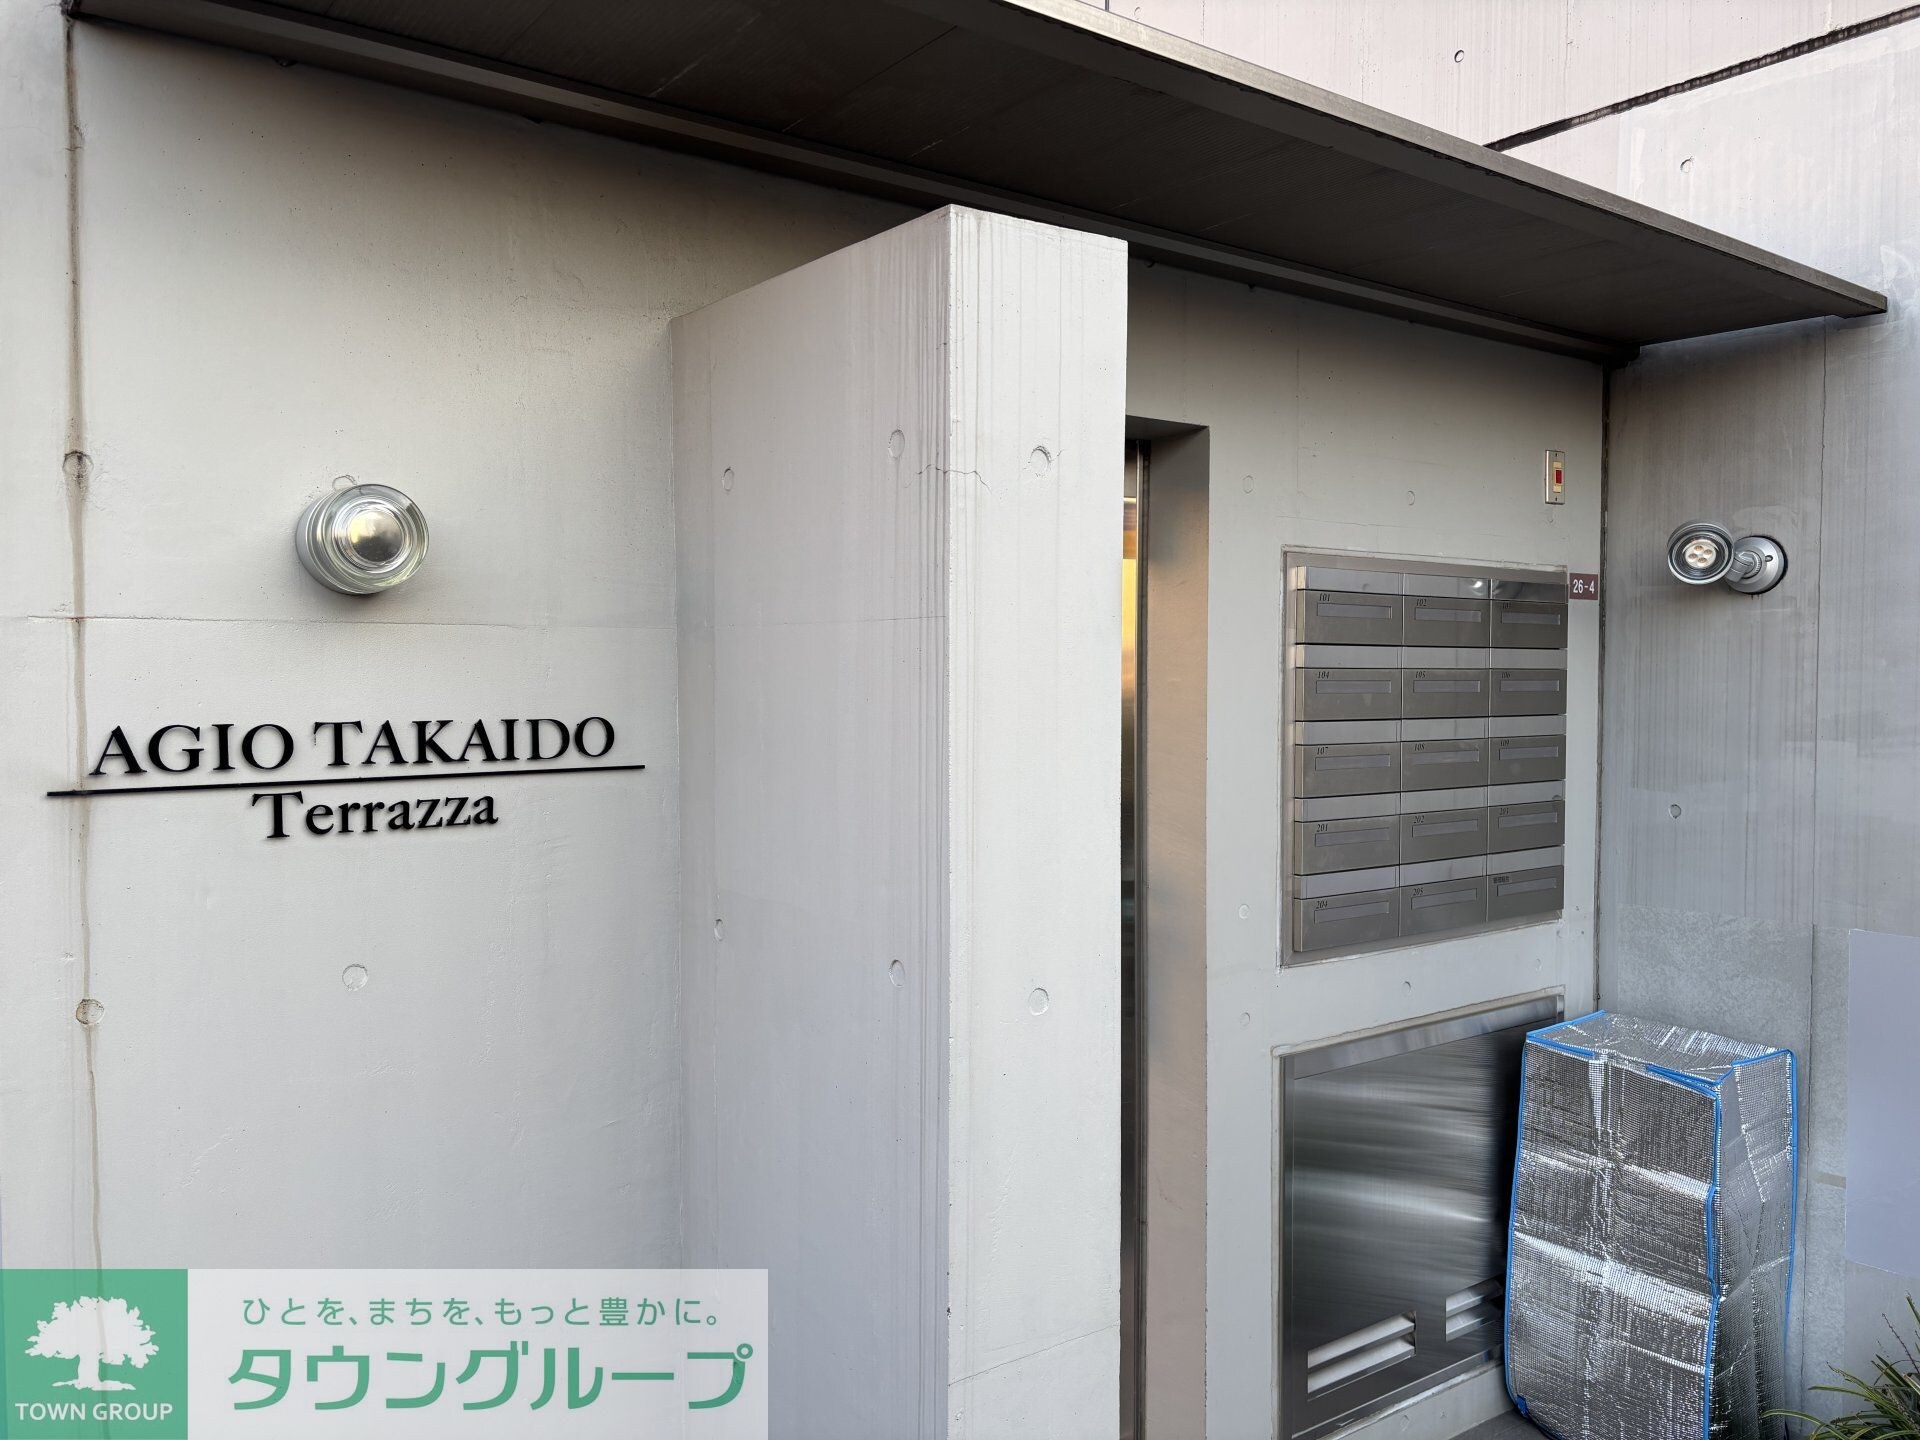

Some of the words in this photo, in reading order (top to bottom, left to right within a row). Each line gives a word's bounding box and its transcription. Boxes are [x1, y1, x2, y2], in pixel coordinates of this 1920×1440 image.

[1573, 578, 1595, 594] 26-4
[1318, 593, 1330, 602] 101
[1416, 598, 1427, 607] 102
[1317, 671, 1330, 679] 104
[89, 724, 294, 777] AGIO
[314, 717, 616, 767] TAKAIDO
[1316, 746, 1329, 755] 107
[251, 791, 499, 840] Terrazza
[1414, 815, 1425, 824] 202
[1316, 824, 1328, 832] 201
[1315, 900, 1328, 909] 204
